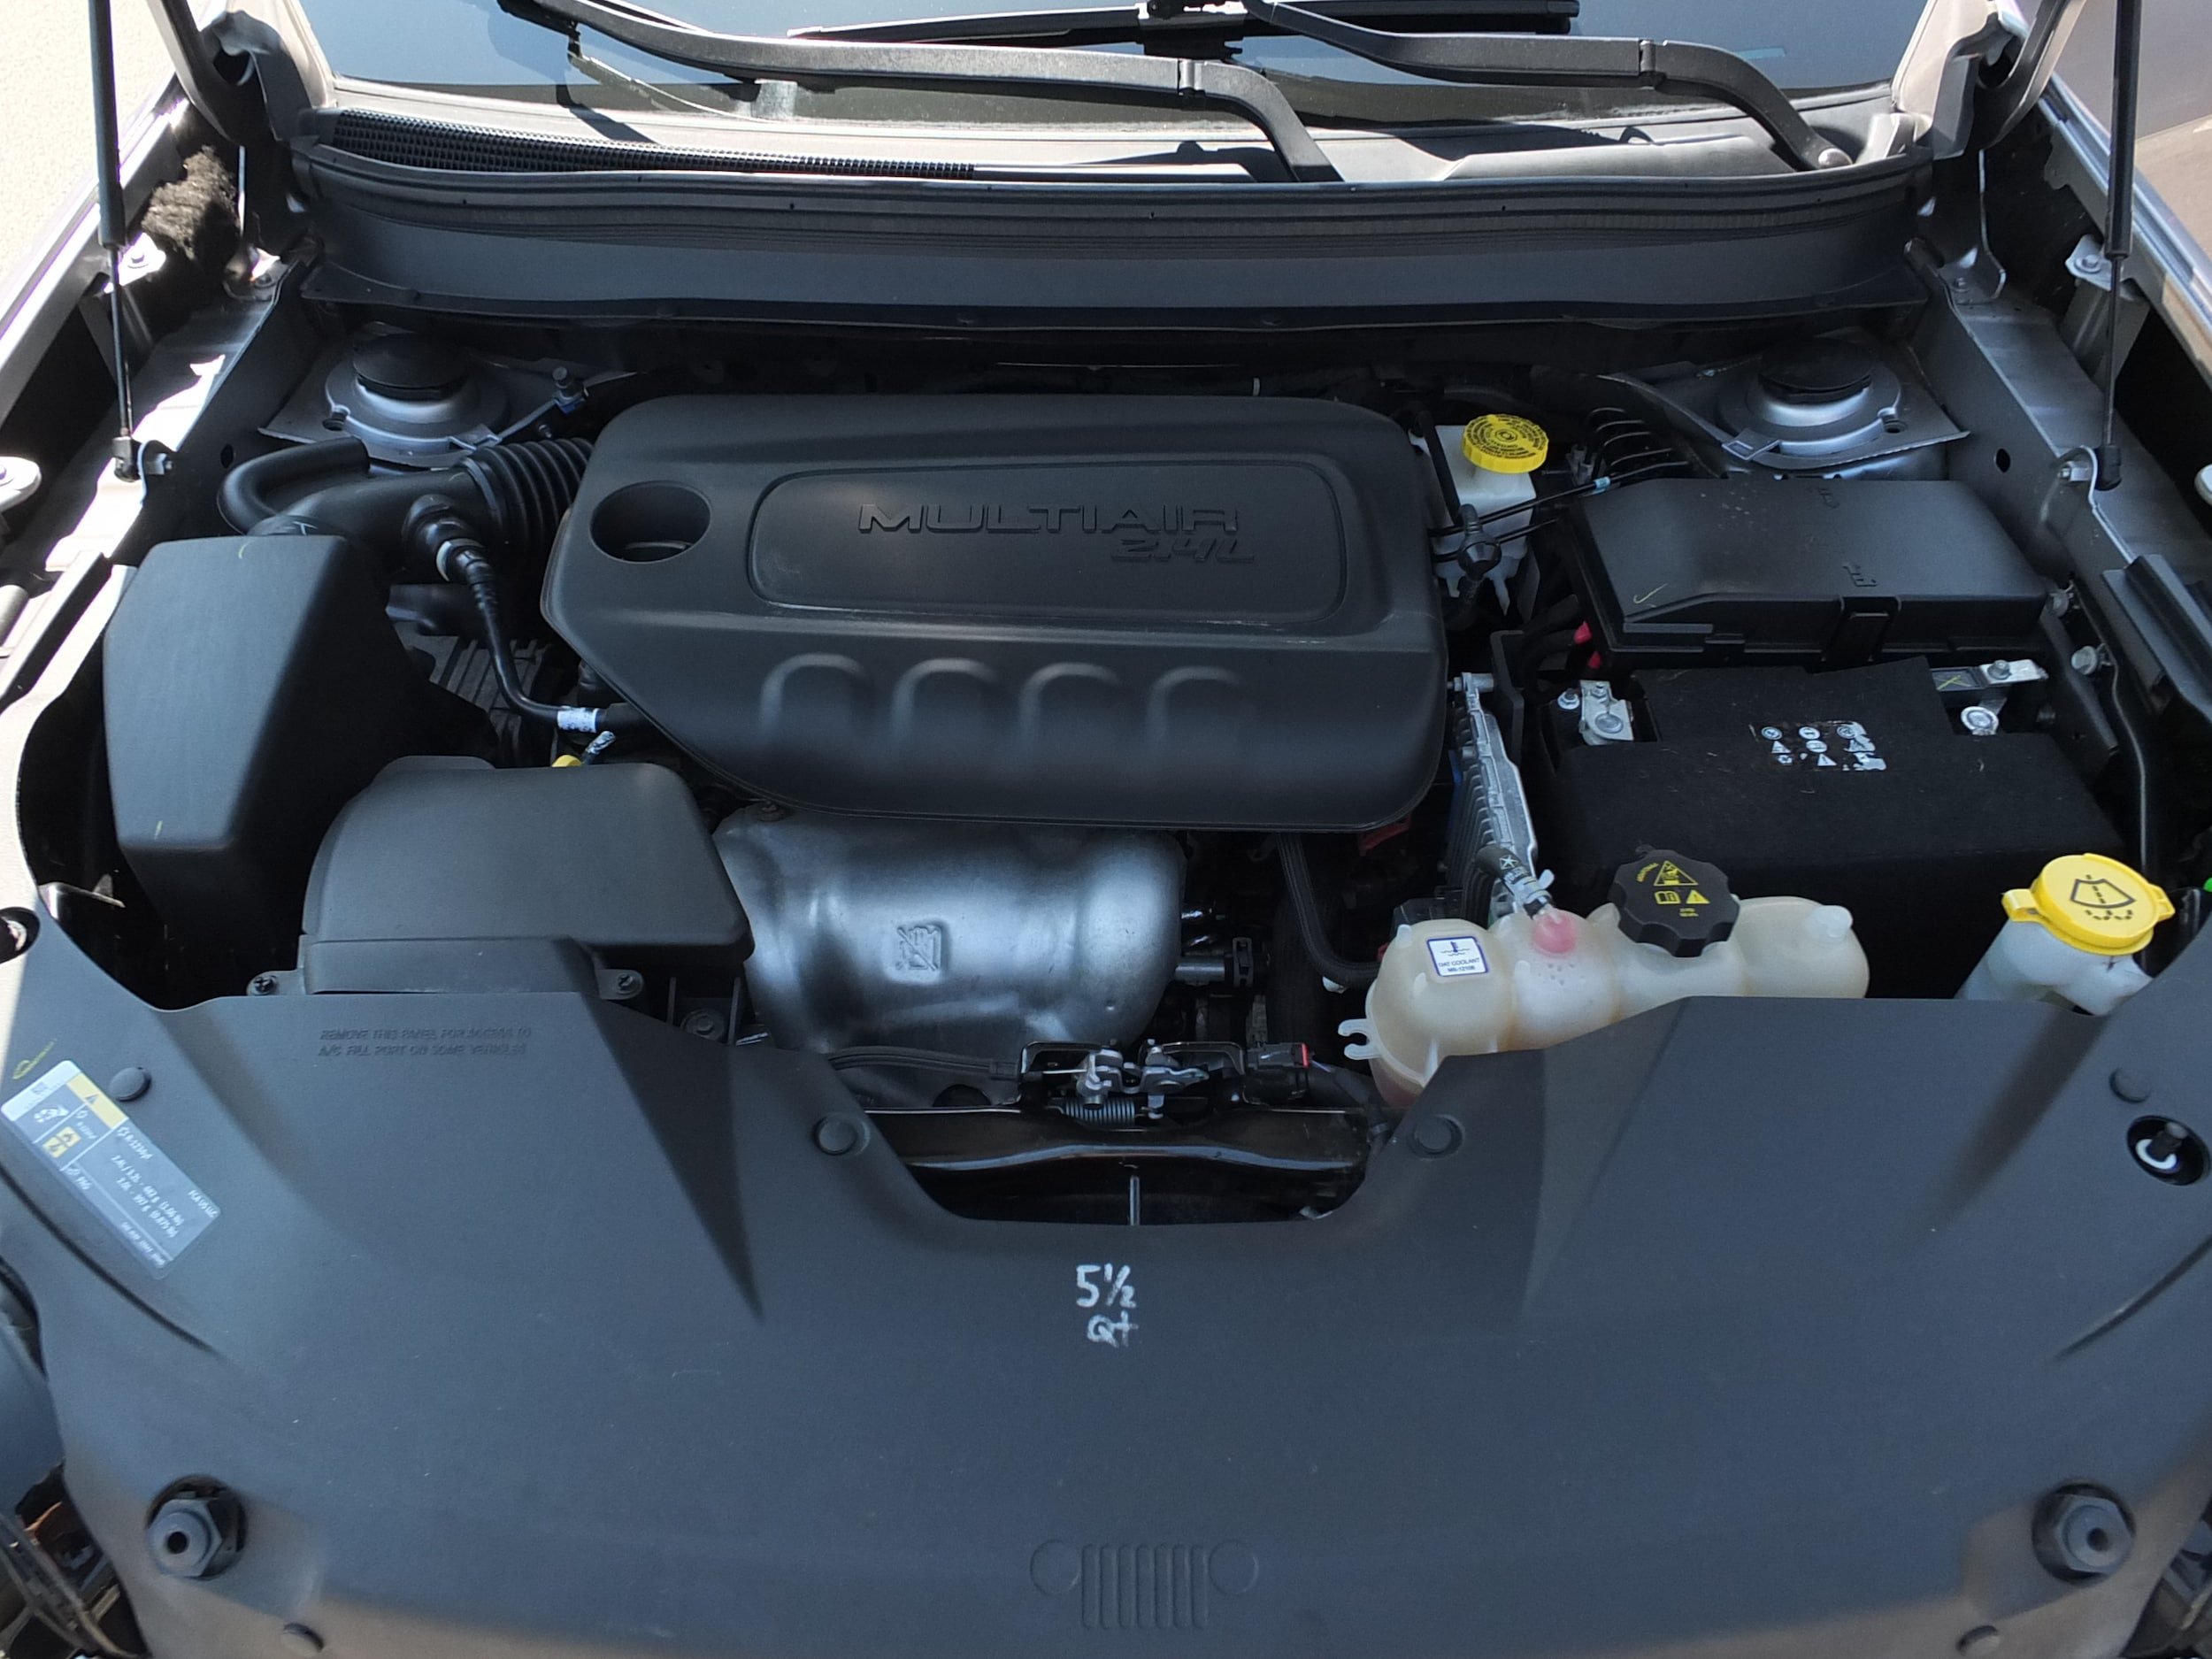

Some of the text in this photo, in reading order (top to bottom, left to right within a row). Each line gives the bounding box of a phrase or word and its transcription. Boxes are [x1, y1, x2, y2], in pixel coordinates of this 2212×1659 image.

[858, 503, 1239, 534] MULTIAIR
[1111, 539, 1255, 563] 2.4L
[320, 1030, 369, 1040] REMOVE
[373, 1030, 397, 1040] THIS
[402, 1029, 437, 1040] PANEL
[441, 1029, 465, 1039] FOR
[518, 1028, 531, 1038] TO
[319, 1044, 526, 1056] A/C FILL PORT ON SOME VEHICLES
[1087, 1310, 1139, 1348] Qt
